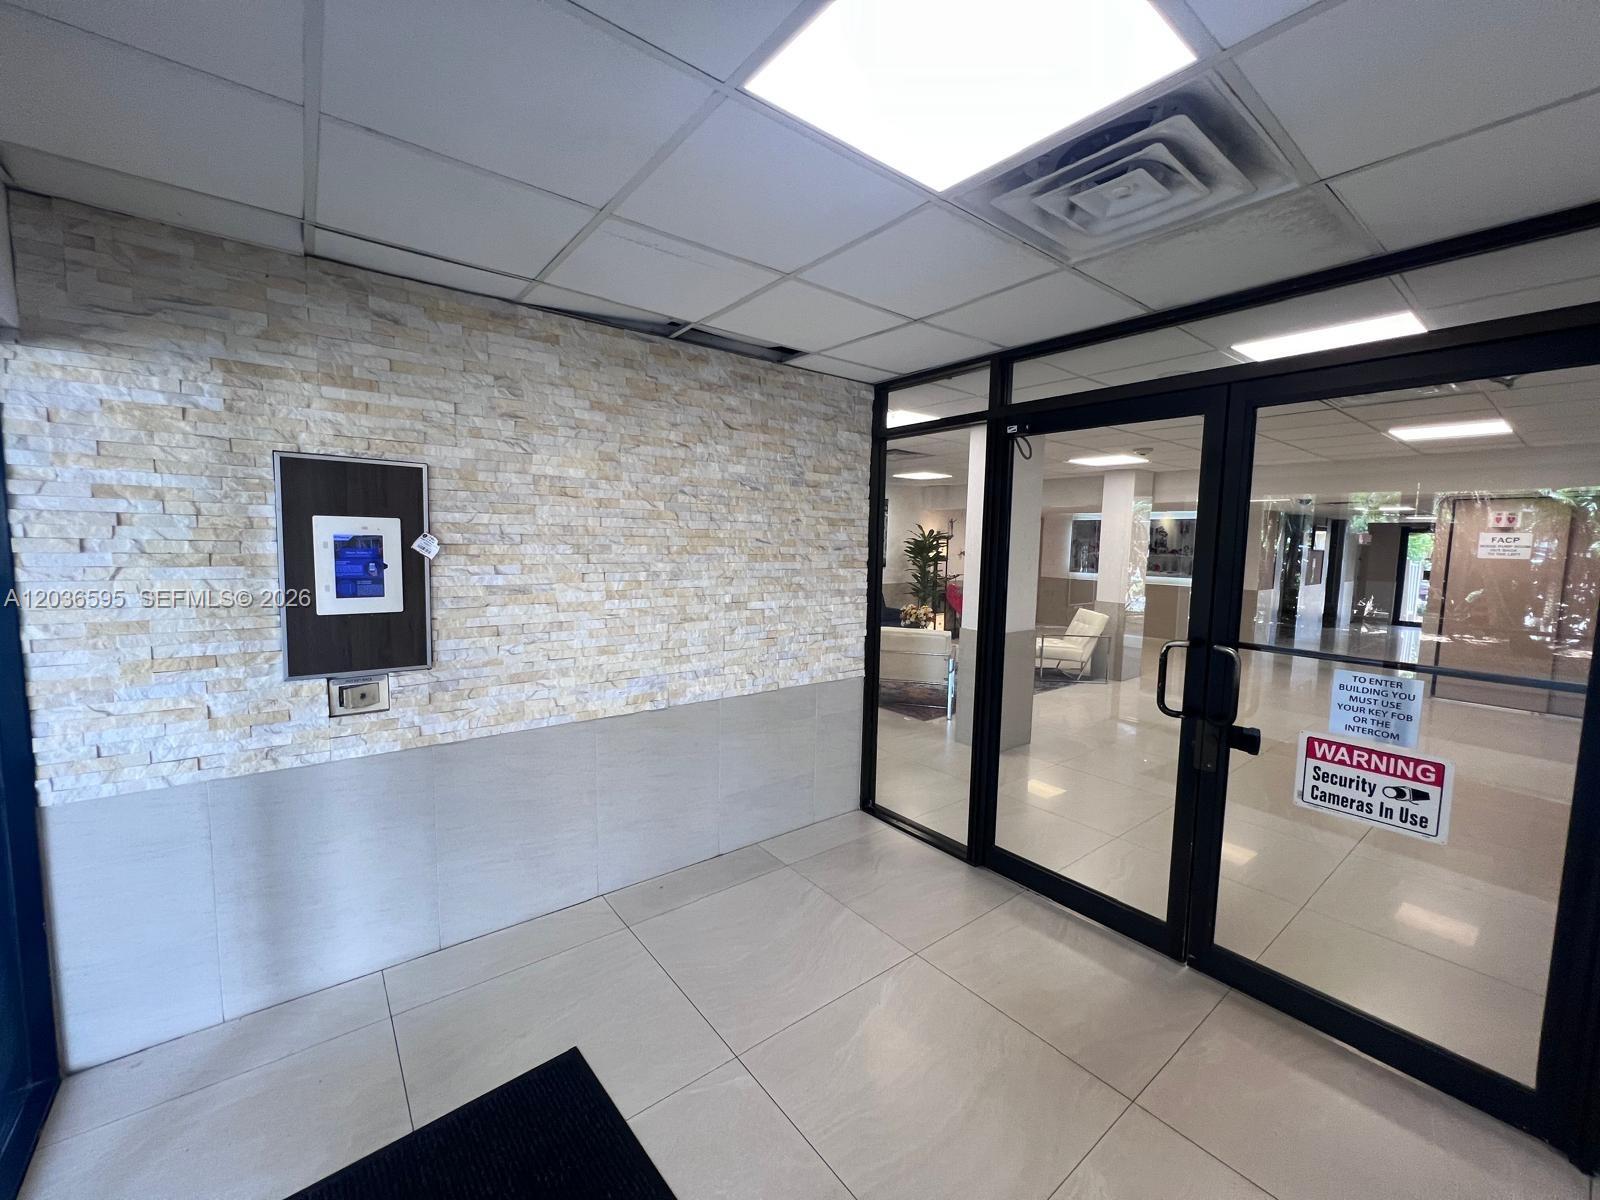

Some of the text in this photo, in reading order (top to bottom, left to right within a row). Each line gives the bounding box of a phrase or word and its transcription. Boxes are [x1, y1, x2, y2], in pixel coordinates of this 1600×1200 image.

[1352, 675, 1403, 689] TO ENTER
[1338, 683, 1416, 702] BUILDING YOU
[1337, 702, 1413, 722] YOUR KEY FOB
[1349, 695, 1402, 710] MUST USE
[1352, 715, 1391, 729] OR THE
[1344, 723, 1400, 741] INTERCOM
[1313, 741, 1437, 782] WARNING
[1312, 765, 1377, 798] Security
[1310, 784, 1429, 829] Cameras In Use
